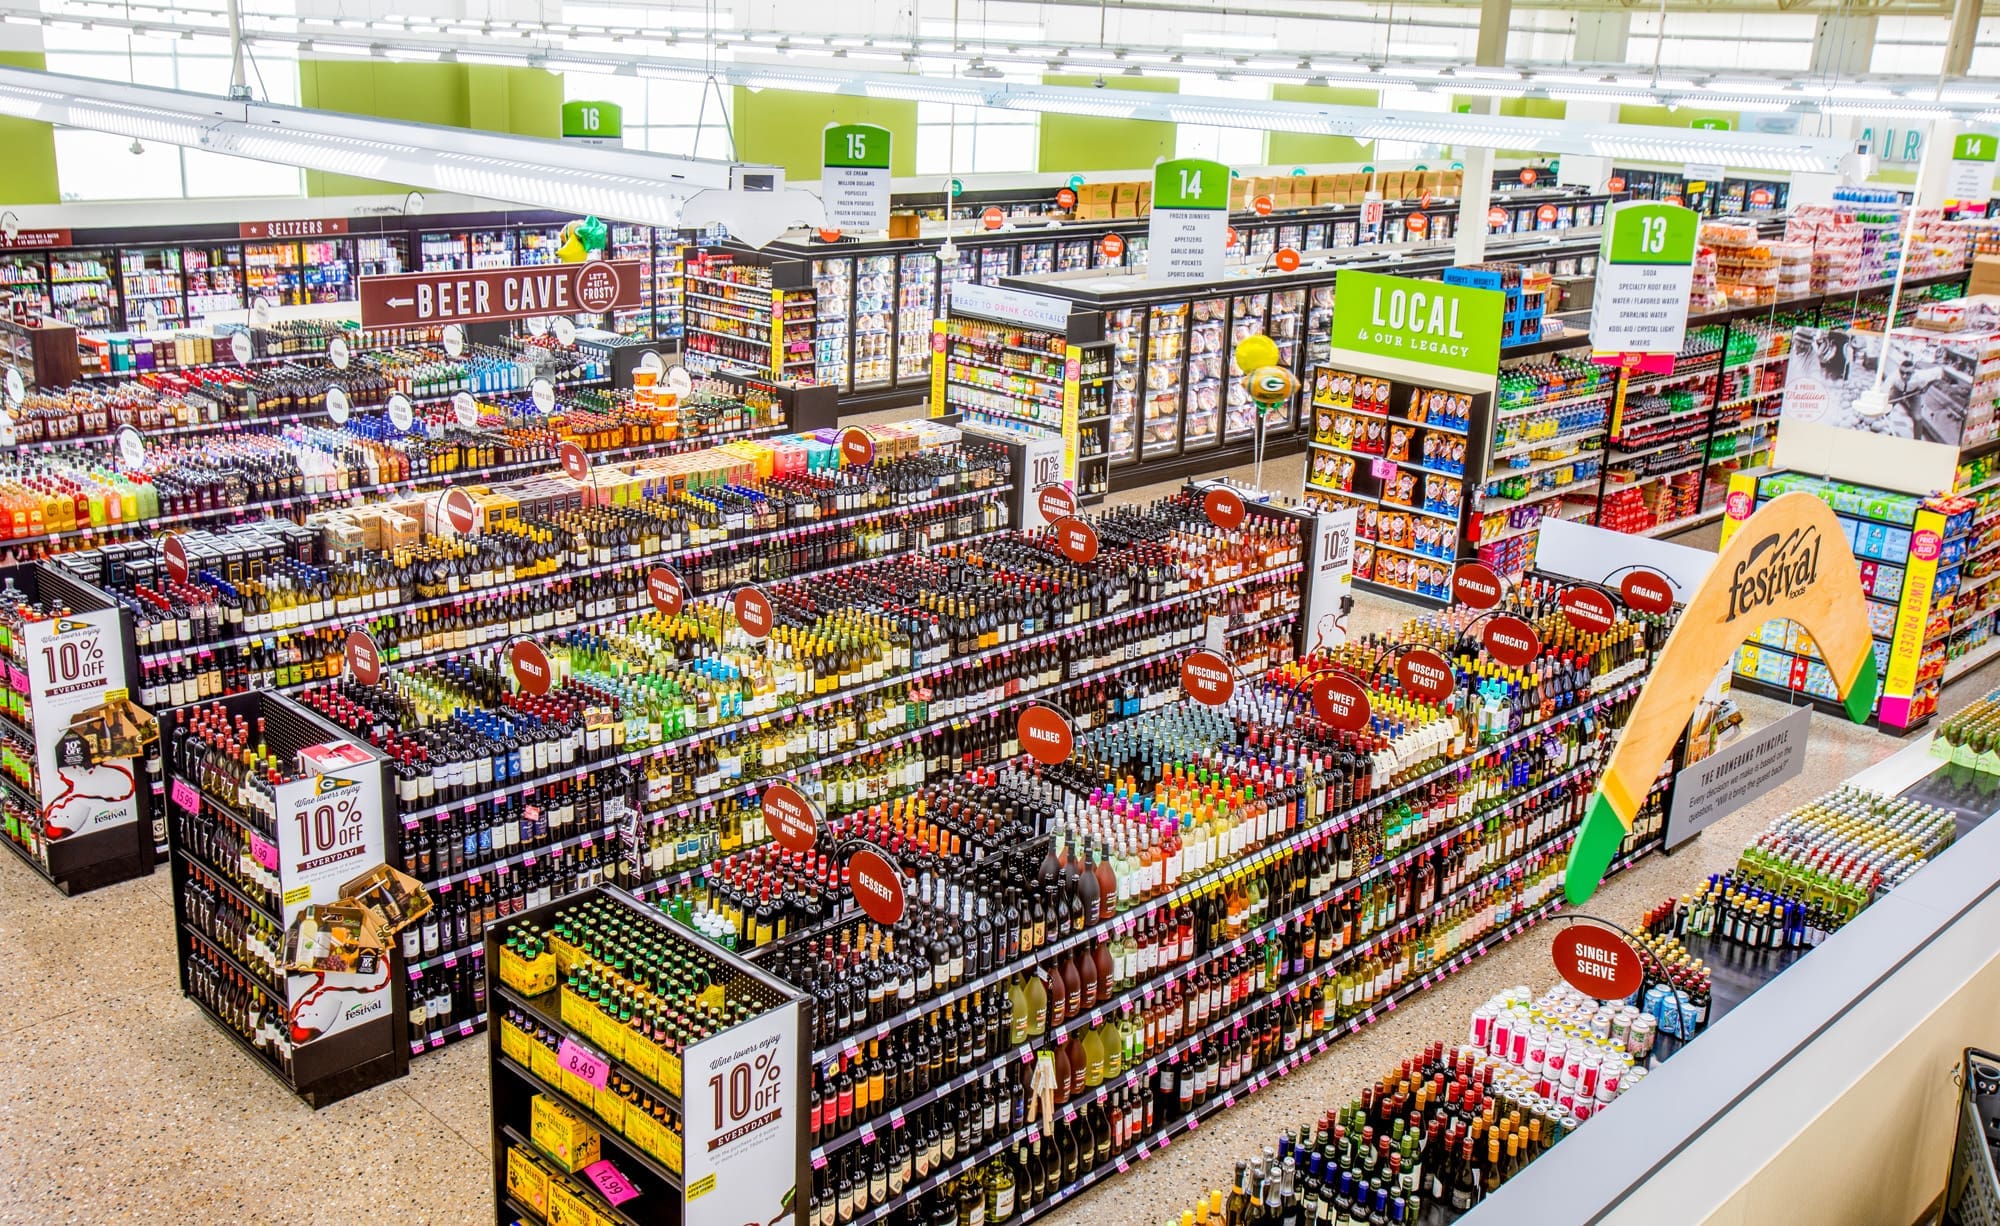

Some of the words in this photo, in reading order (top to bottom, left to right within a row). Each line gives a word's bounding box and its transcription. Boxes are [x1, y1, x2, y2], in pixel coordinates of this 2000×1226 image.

[581, 108, 600, 131] 16
[846, 133, 866, 160] 15
[1965, 138, 1982, 157] 14
[1179, 169, 1202, 200] 14
[1367, 202, 1382, 224] EXIT
[268, 221, 323, 236] SELTZERS
[1641, 216, 1667, 253] 13
[417, 279, 491, 319] BEER
[504, 274, 569, 312] CAVE
[583, 286, 615, 301] FROSTY
[954, 296, 978, 307] READY
[982, 302, 991, 310] TO
[994, 303, 1019, 315] DRINK
[1023, 309, 1066, 323] COCKTAILS
[1372, 287, 1464, 339] LOCAL
[1358, 328, 1369, 341] is
[1374, 332, 1403, 347] OUR
[1411, 338, 1470, 357] LEGACY
[1785, 391, 1825, 400] Tradition
[1800, 383, 1816, 391] PROUD
[1033, 455, 1059, 484] 10%
[1048, 471, 1059, 481] OFF
[1042, 503, 1071, 519] SAUVIGNON
[1044, 495, 1070, 509] CABERNET
[1217, 503, 1232, 515] ROSÉ
[1070, 530, 1087, 543] PINOT
[1071, 540, 1085, 552] NOIR
[1324, 528, 1350, 562] 10%
[1338, 545, 1349, 558] OFF
[1725, 530, 1821, 622] festival
[651, 578, 679, 596] SAUVIGNON
[1458, 577, 1496, 597] SPARKLING
[1631, 584, 1663, 602] ORGANIC
[1789, 586, 1806, 600] foods
[1907, 575, 1927, 613] LOWER
[657, 591, 674, 605] BLANC
[745, 600, 762, 613] PINOT
[1575, 600, 1597, 613] RIESLING
[1598, 606, 1603, 614] &
[744, 611, 763, 625] GRIGIO
[1492, 632, 1529, 651] MOSCATO
[1898, 614, 1921, 660] PRICES!
[41, 637, 104, 684] 10%
[354, 645, 371, 660] PETITE
[83, 660, 105, 677] OFF
[356, 657, 371, 673] SIRAH
[519, 659, 543, 678] MERLOT
[1187, 664, 1228, 683] WISCONSIN
[1407, 661, 1445, 681] MOSCATO
[53, 679, 101, 696] EVERYDAY!
[1198, 677, 1217, 692] WINE
[1412, 673, 1438, 690] D'ASTI
[1327, 689, 1356, 707] SWEET
[1332, 703, 1349, 717] RED
[1029, 726, 1060, 744] MALBEC
[1701, 769, 1715, 787] THE
[1715, 748, 1754, 779] BOOMERANG
[1755, 730, 1789, 757] PRINCIPLE
[1688, 793, 1705, 808] Every
[1706, 780, 1730, 799] decision
[1730, 775, 1739, 784] we
[1739, 766, 1754, 780] make
[1755, 763, 1760, 772] is
[1760, 754, 1776, 769] based
[1776, 751, 1783, 759] on
[1783, 746, 1793, 756] the
[1732, 785, 1747, 798] bring
[1747, 780, 1756, 789] the
[1756, 772, 1771, 787] guest
[176, 789, 193, 807] 15.99
[294, 797, 315, 808] Wine
[316, 791, 339, 803] lovers
[339, 785, 361, 798] enjoy
[94, 808, 128, 824] festival
[777, 798, 802, 817] EUROPE/
[294, 796, 362, 856] 10%
[765, 804, 784, 820] SOUTH
[784, 813, 814, 836] AMERICAN
[781, 822, 797, 838] WINE
[339, 824, 364, 846] OFF
[306, 848, 359, 869] EVERYDAY!
[859, 871, 893, 903] DESSERT
[1575, 943, 1618, 966] SINGLE
[1577, 959, 1616, 981] SERVE
[345, 1000, 382, 1021] festival
[709, 1055, 732, 1070] Wine
[733, 1046, 759, 1062] lovers
[759, 1032, 781, 1050] enjoy
[570, 1055, 596, 1079] 8.49
[708, 1047, 781, 1131] 10%
[755, 1081, 781, 1112] OFF
[534, 1102, 549, 1116] New
[549, 1111, 569, 1137] Glarus
[718, 1113, 774, 1147] EVERYDAY!
[510, 1151, 524, 1168] New
[523, 1162, 545, 1188] Glarus
[595, 1169, 624, 1195] 14.99
[552, 1187, 567, 1202] New
[567, 1197, 590, 1226] Glarus
